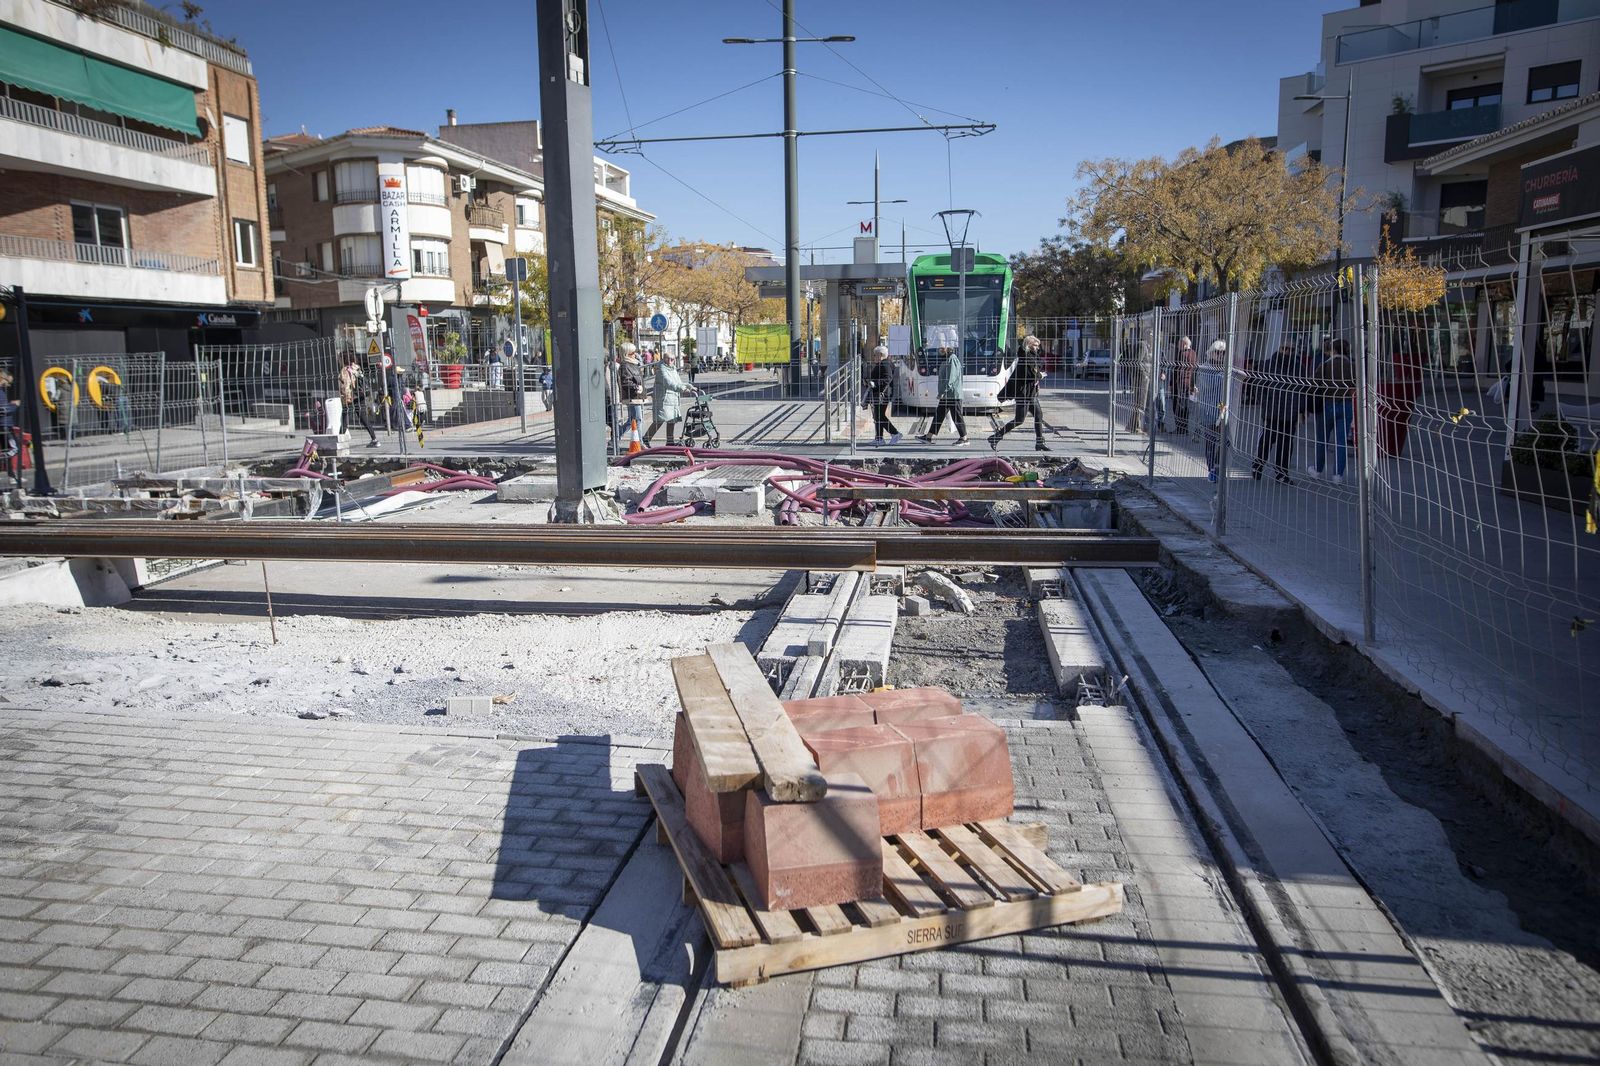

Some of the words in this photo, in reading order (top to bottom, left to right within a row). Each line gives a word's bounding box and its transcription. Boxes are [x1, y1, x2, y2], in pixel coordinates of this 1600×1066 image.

[1524, 165, 1578, 193] CHURRERÍA
[382, 192, 405, 200] BAZAR
[860, 222, 872, 234] M
[390, 209, 402, 266] ARMILLA
[907, 926, 942, 944] SIERRA
